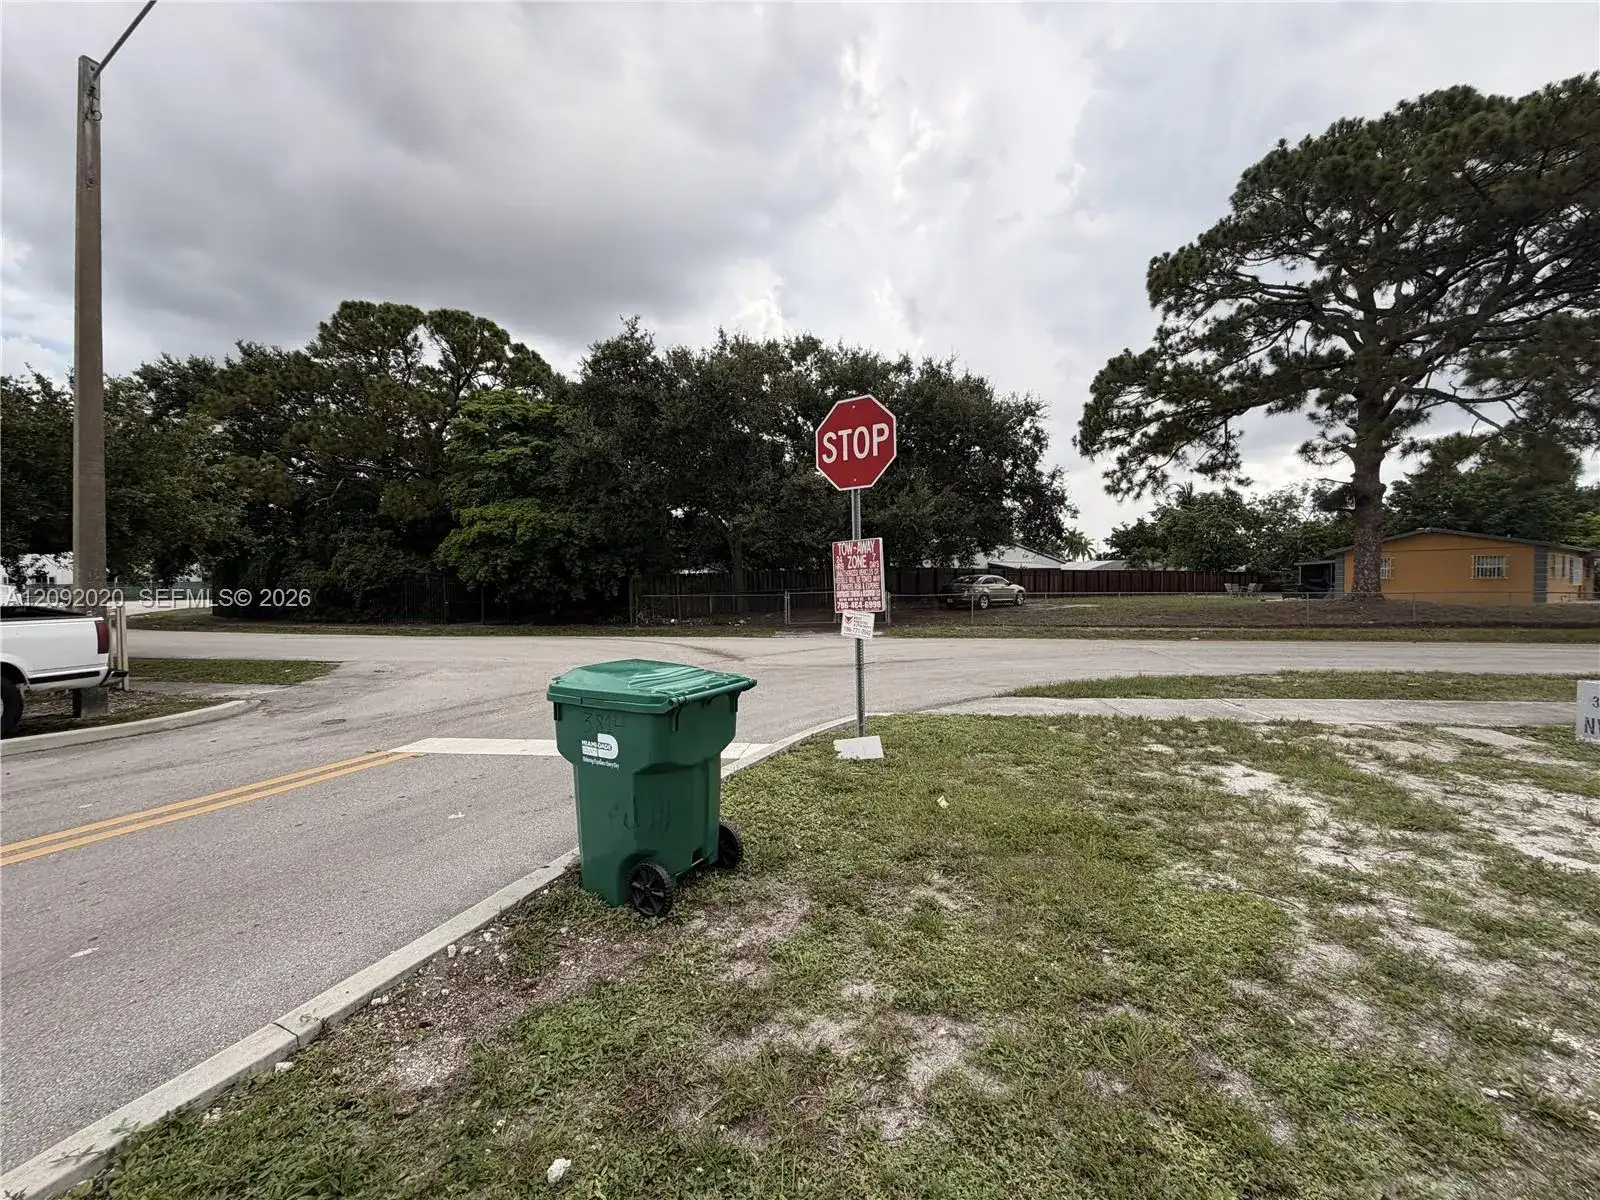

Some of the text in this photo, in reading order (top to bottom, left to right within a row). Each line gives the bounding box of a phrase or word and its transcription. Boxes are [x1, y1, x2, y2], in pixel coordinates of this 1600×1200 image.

[822, 423, 889, 464] STOP
[837, 540, 875, 556] TOW-AWAY
[847, 554, 867, 569] ZONE
[872, 553, 877, 561] 7
[869, 560, 880, 569] DAYS
